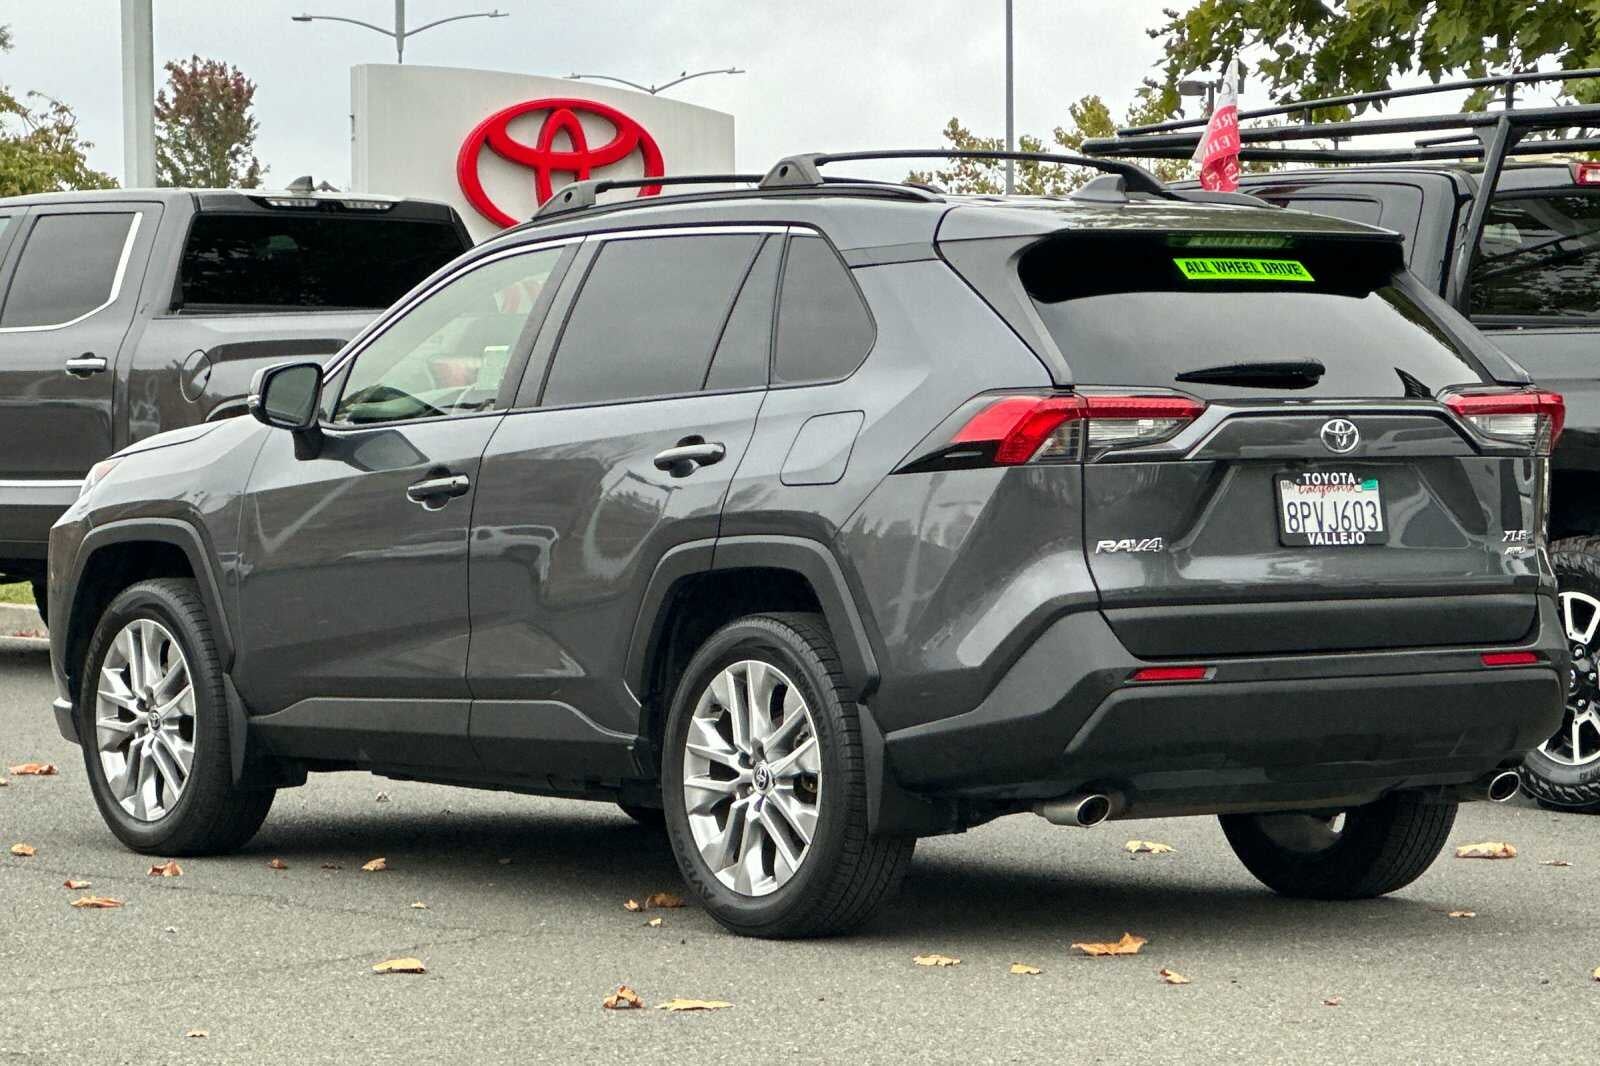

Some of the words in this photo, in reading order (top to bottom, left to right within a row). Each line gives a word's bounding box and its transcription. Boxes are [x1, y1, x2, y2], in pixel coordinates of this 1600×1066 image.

[1184, 261, 1212, 274] ALL
[1211, 261, 1261, 275] WHEEL
[1262, 262, 1302, 275] DRIVE
[1302, 472, 1356, 485] TOYOTA
[1287, 500, 1379, 533] 8PVJ603
[1095, 537, 1164, 554] RAV4
[1308, 532, 1365, 545] VALLEJO
